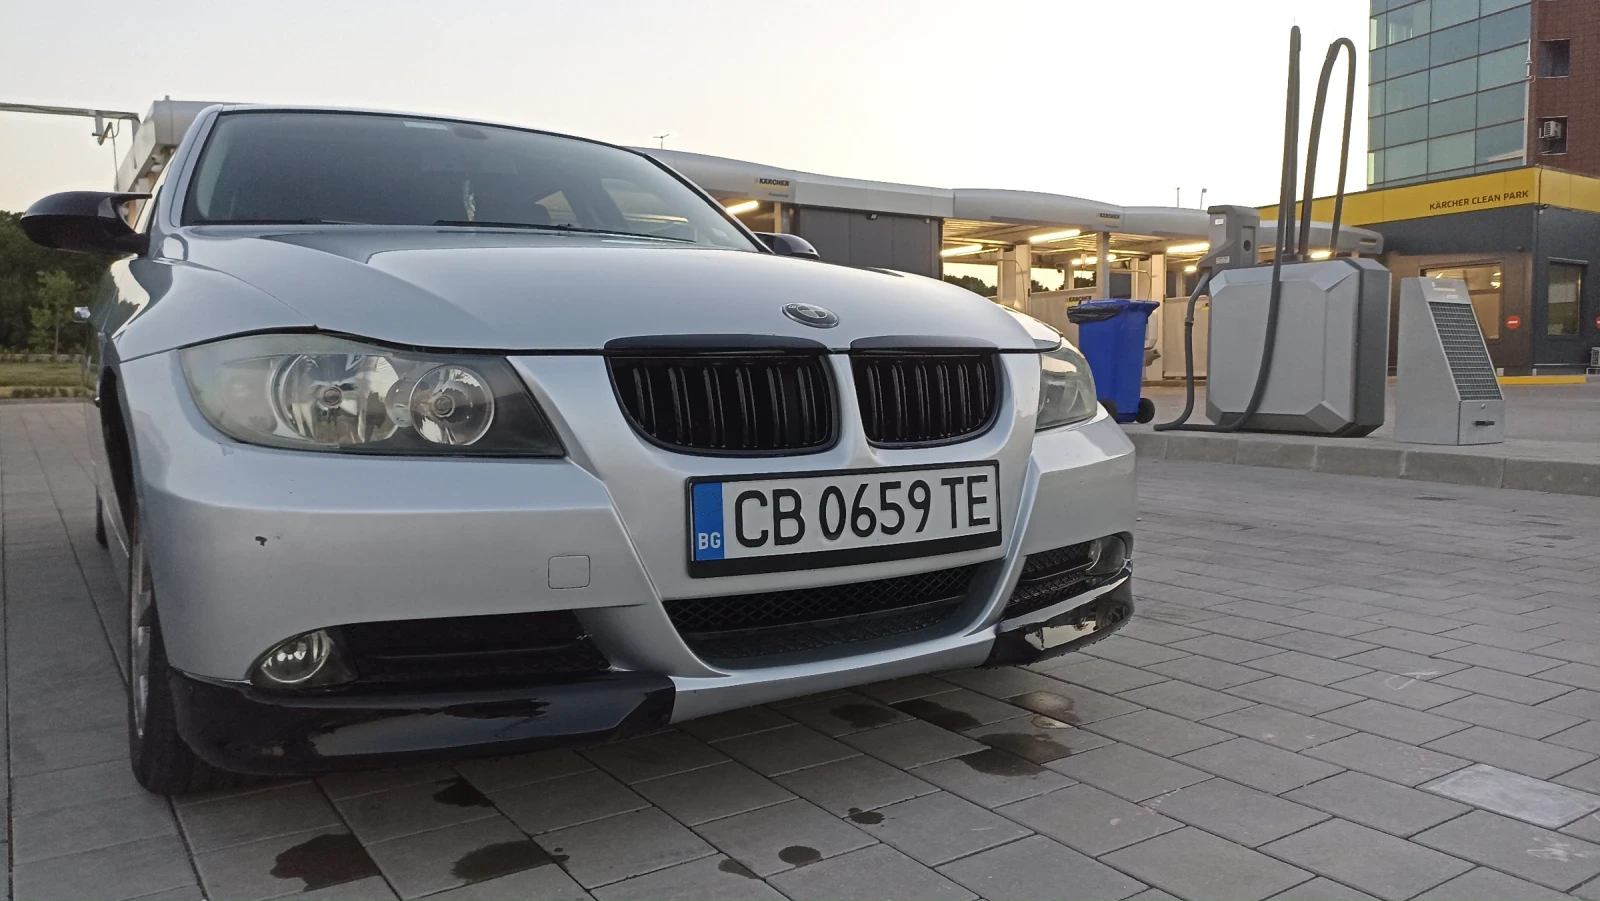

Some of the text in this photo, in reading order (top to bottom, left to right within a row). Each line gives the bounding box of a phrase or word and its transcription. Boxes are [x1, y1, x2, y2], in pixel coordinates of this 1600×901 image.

[1471, 193, 1501, 205] CLEAN
[1503, 190, 1529, 201] PARK
[735, 474, 991, 548] CB 0659 TE
[697, 531, 721, 551] BG
